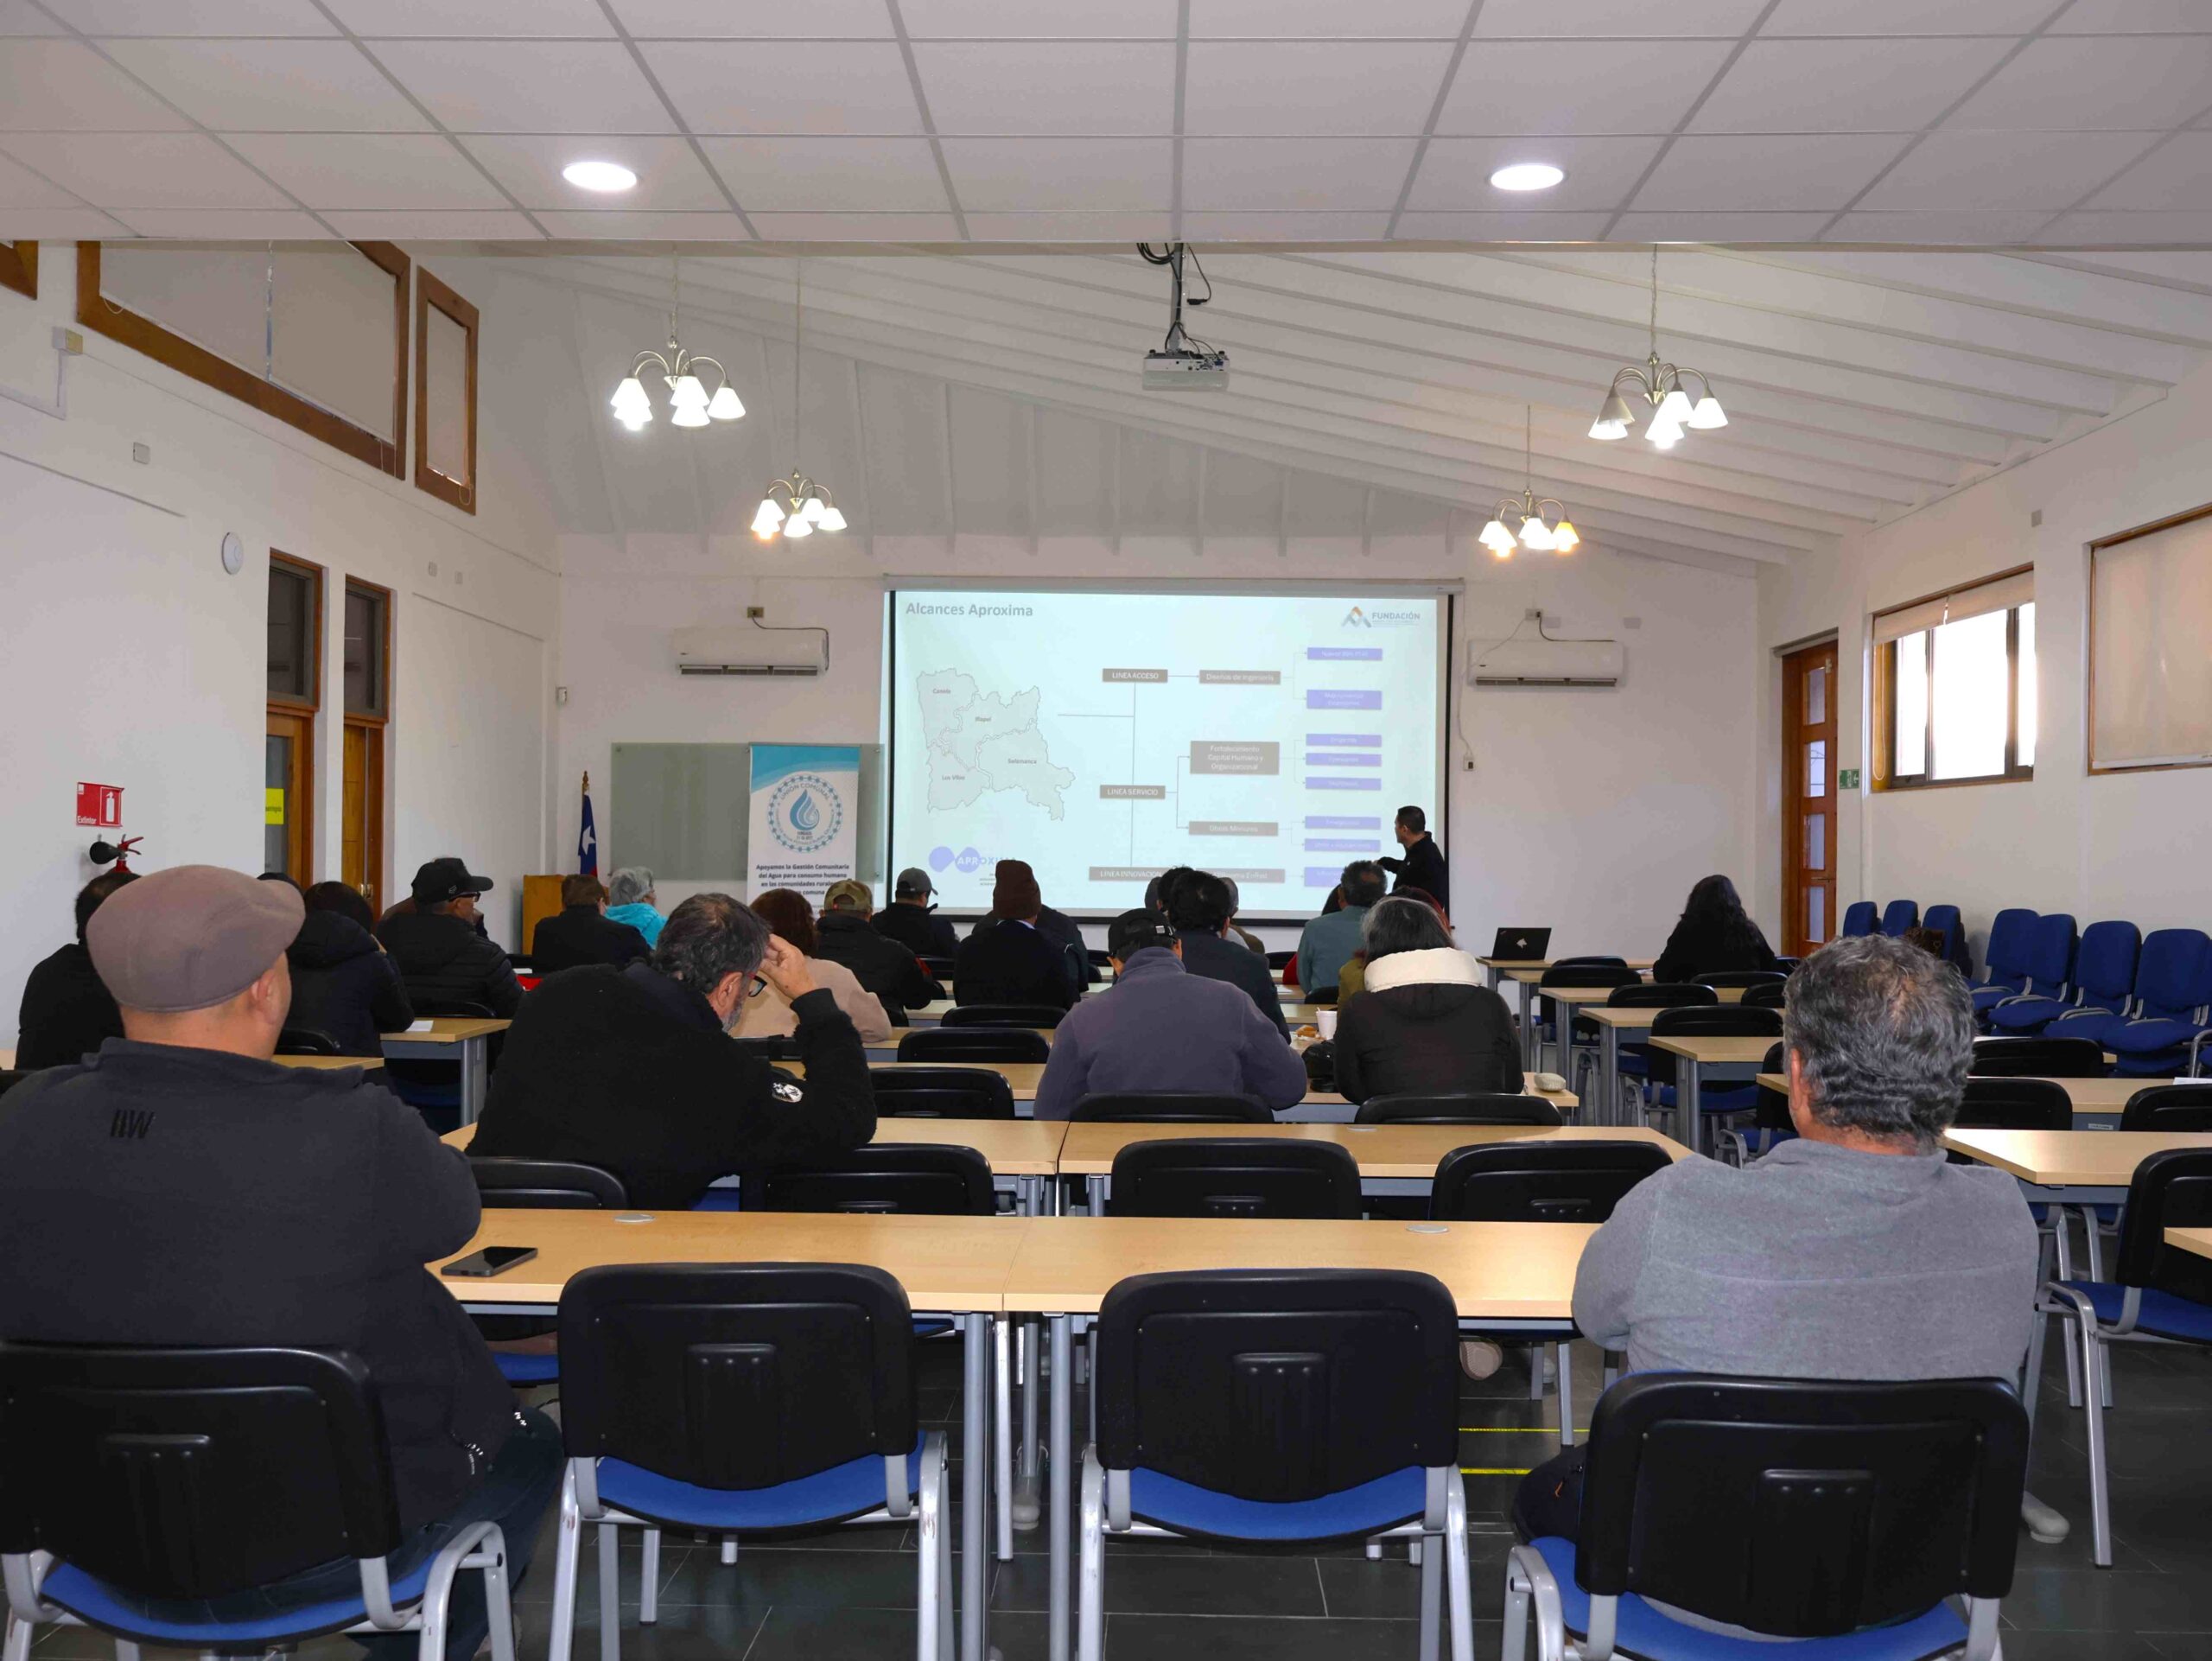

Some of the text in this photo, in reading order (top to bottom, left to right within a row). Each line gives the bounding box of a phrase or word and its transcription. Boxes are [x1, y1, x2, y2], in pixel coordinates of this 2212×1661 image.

[906, 602, 1033, 618] Alcances Aproxima
[1372, 610, 1421, 620] FUNDACIÓN
